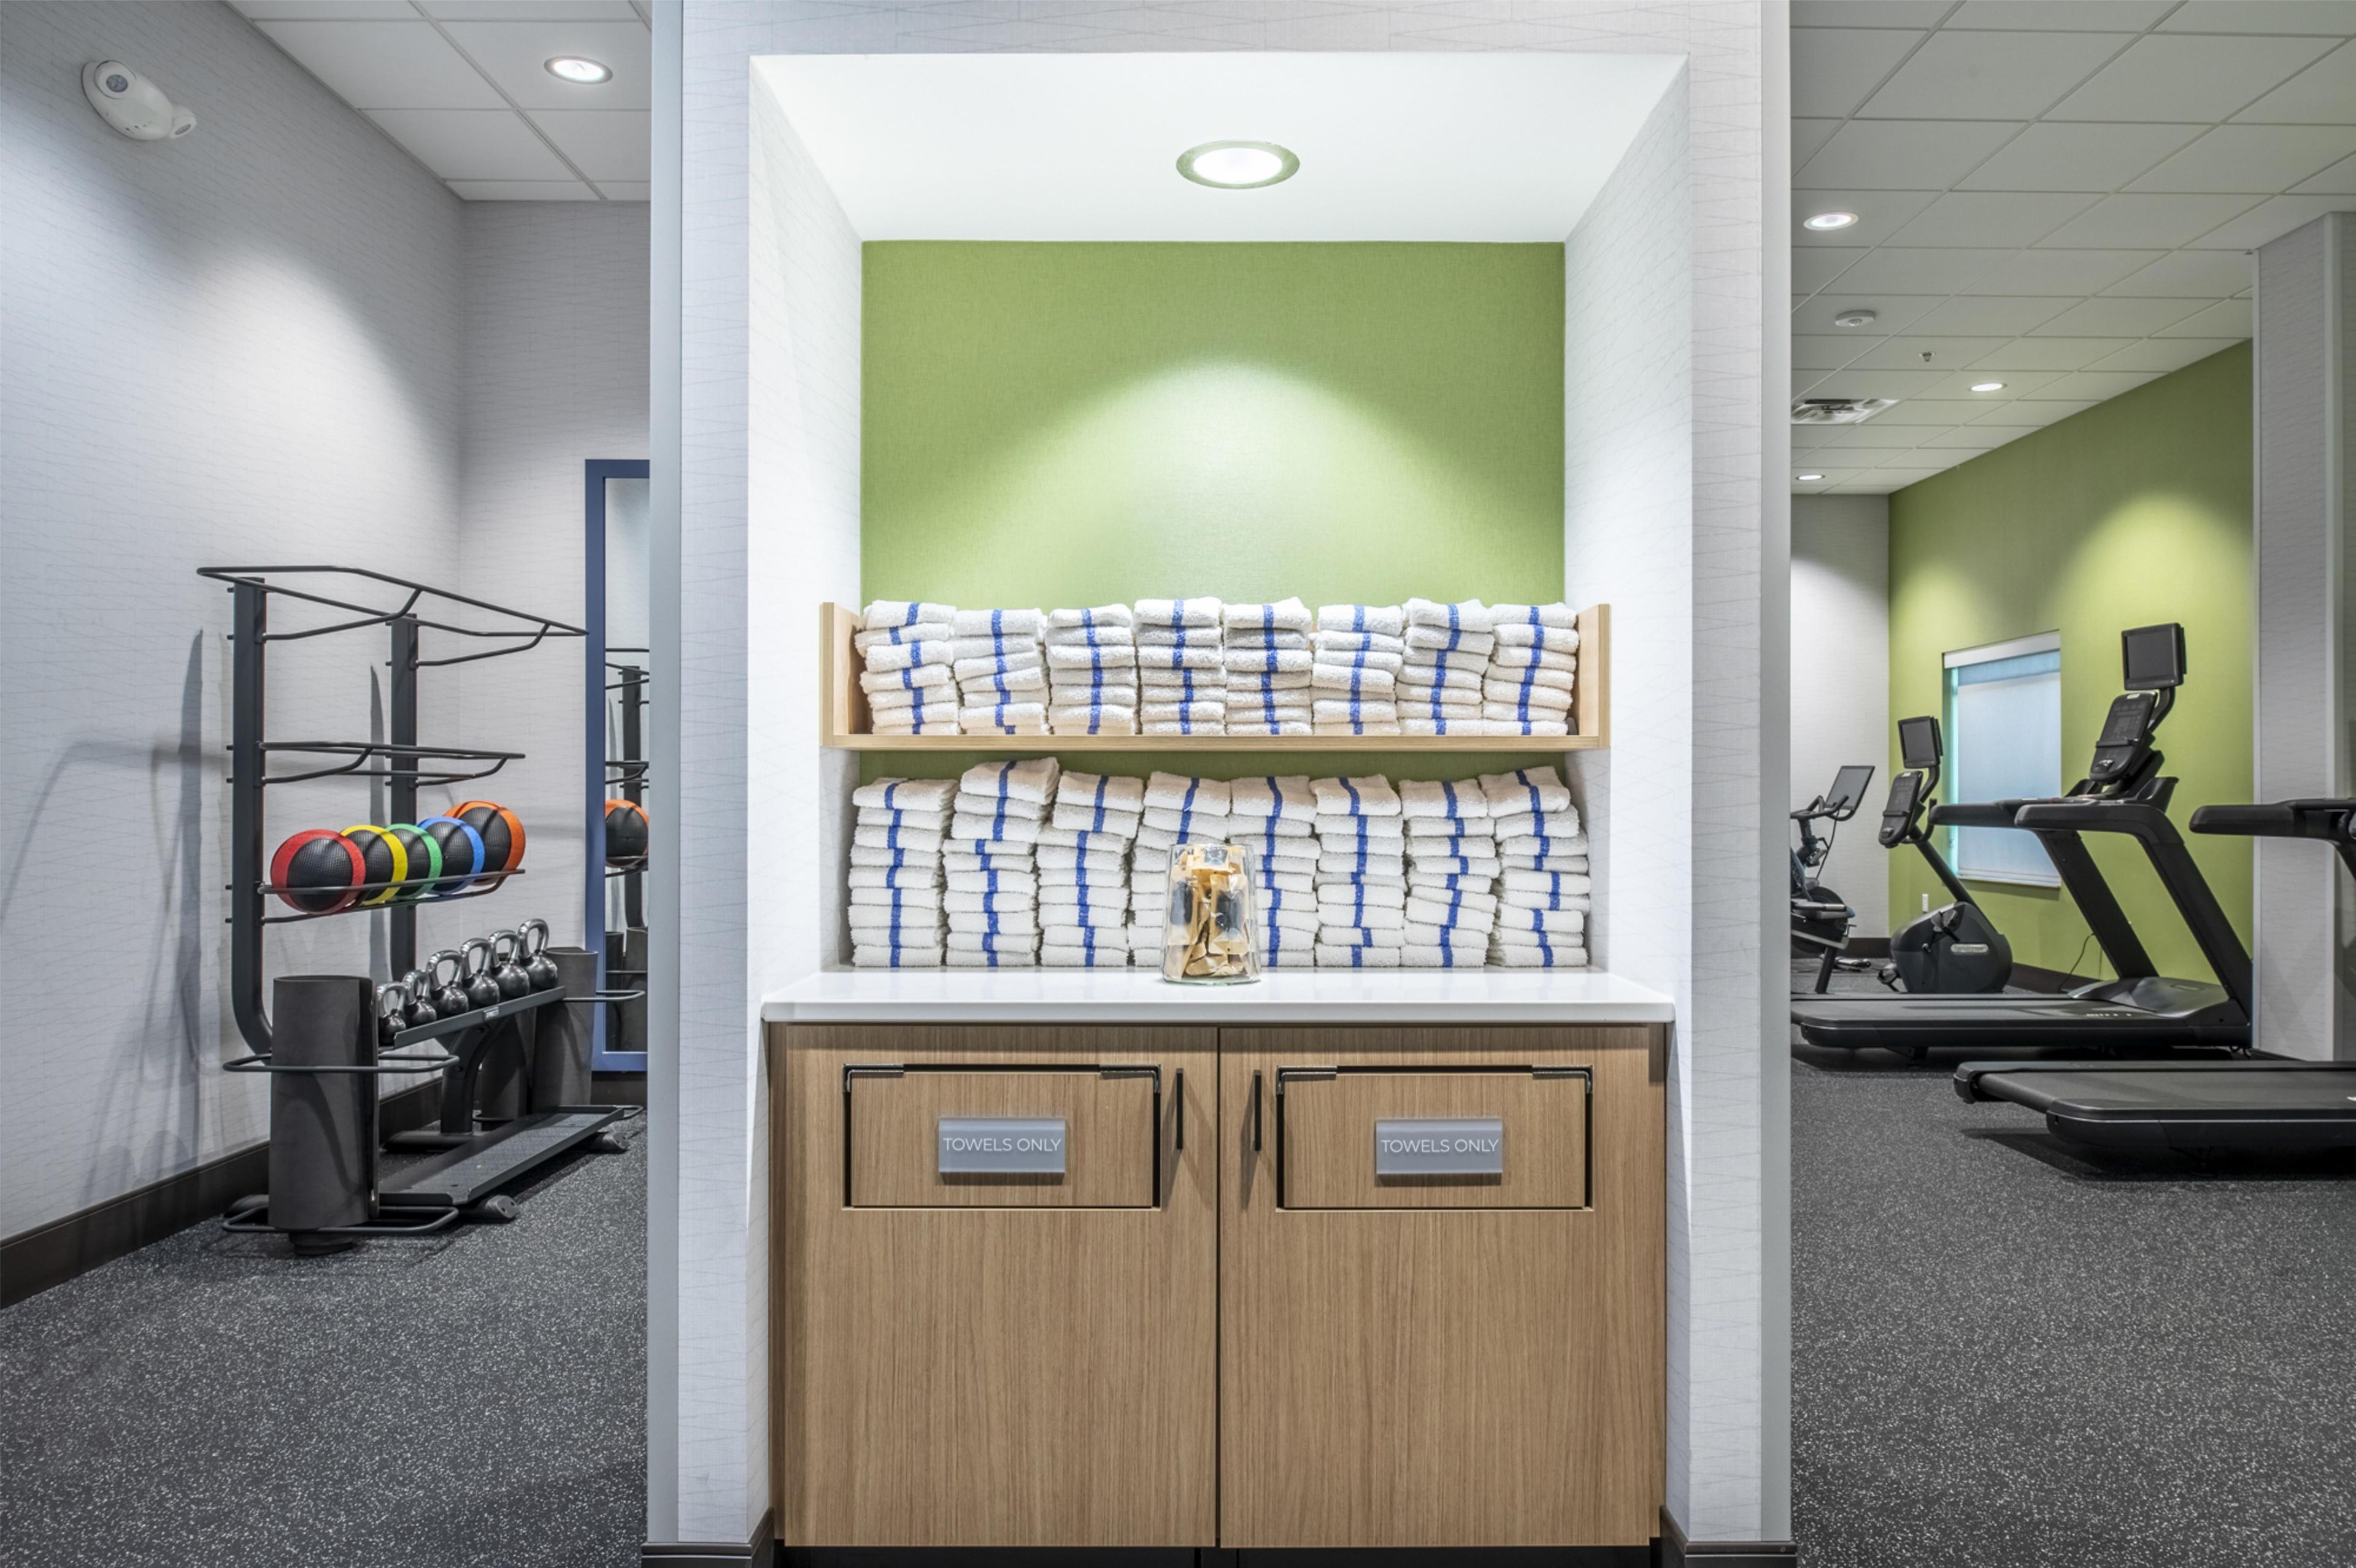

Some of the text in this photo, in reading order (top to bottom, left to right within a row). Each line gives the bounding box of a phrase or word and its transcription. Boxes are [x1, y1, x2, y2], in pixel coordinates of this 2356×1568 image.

[942, 1137, 1061, 1151] TOWELS ONLY
[1380, 1139, 1499, 1153] TOWELS ONLY
